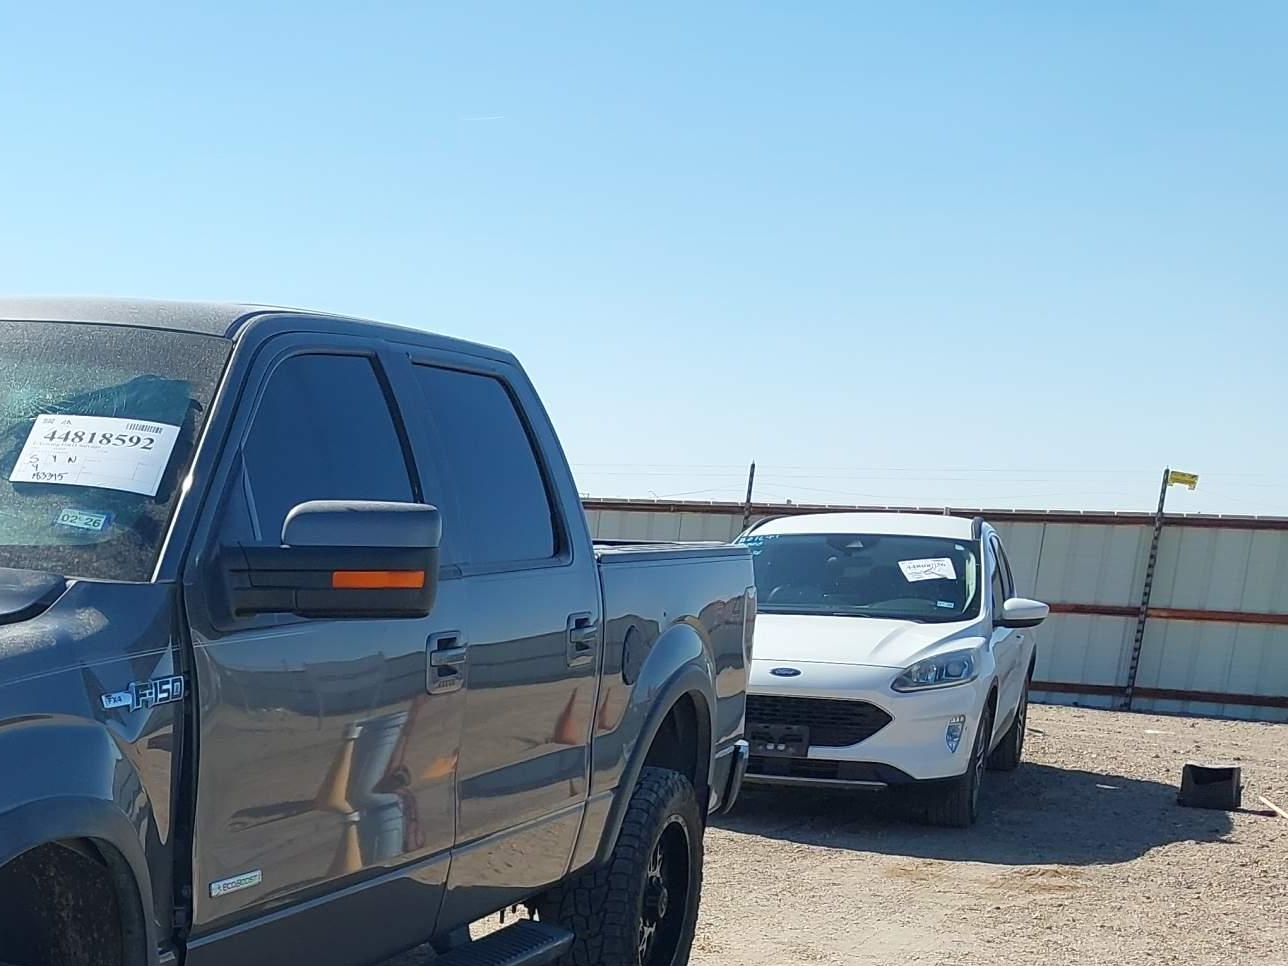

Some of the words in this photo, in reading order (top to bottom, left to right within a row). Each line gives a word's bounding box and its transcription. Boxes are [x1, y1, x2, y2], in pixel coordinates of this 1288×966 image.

[43, 429, 155, 450] 44818592
[61, 513, 78, 524] 02
[84, 517, 102, 528] 26
